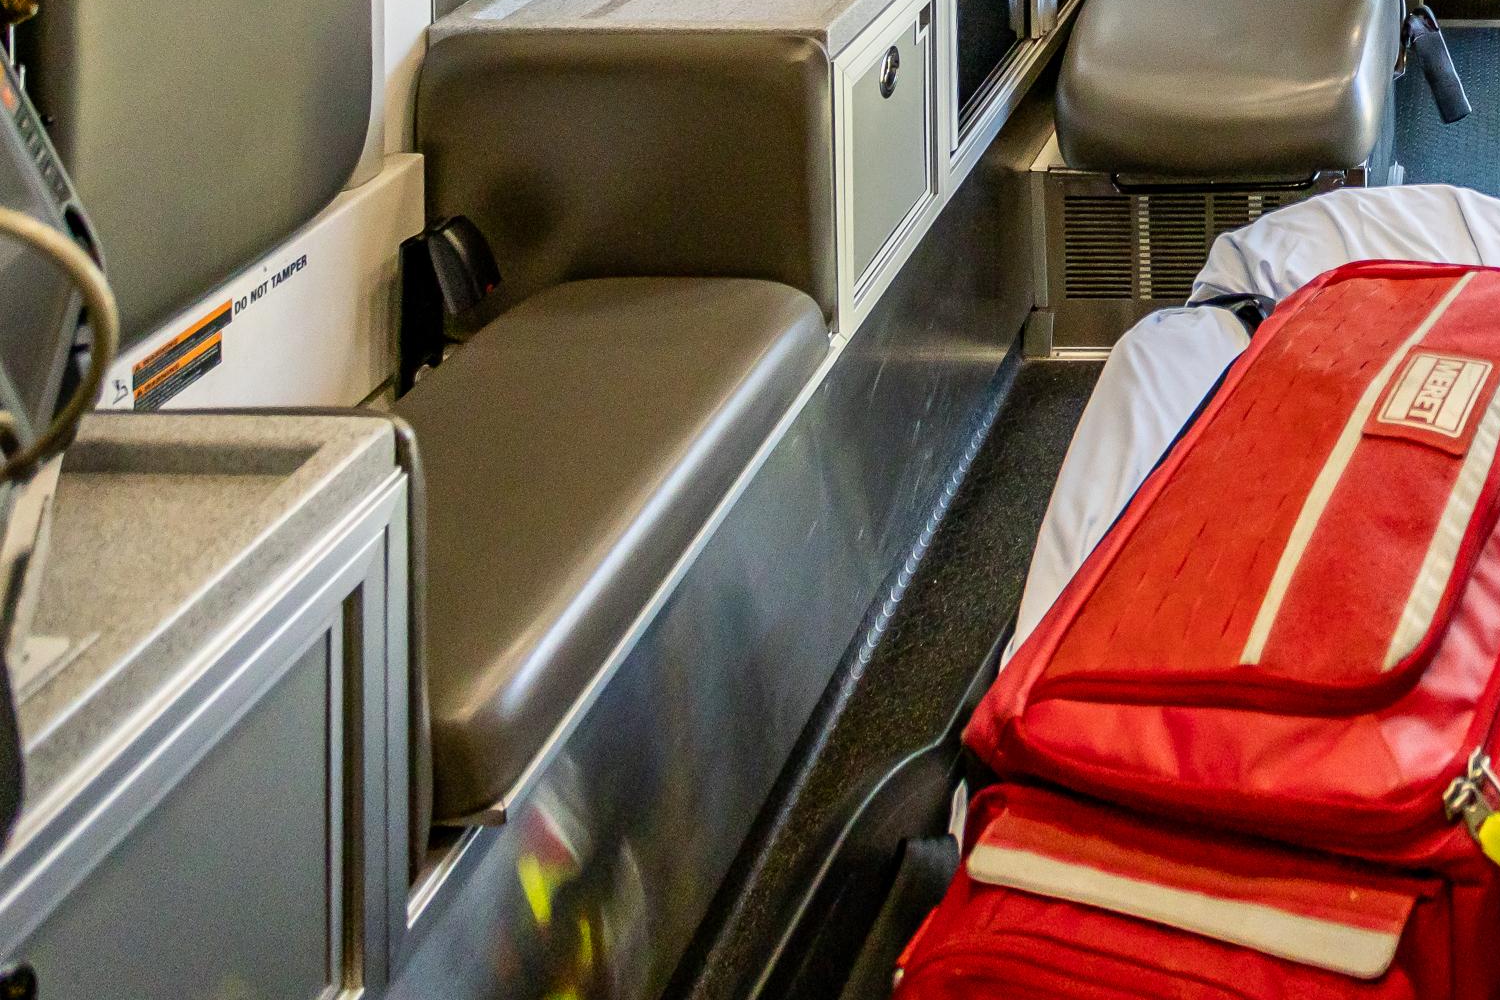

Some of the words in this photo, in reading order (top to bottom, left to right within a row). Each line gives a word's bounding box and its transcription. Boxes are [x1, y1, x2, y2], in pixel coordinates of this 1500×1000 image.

[234, 296, 248, 315] DO
[250, 282, 268, 303] NOT
[271, 254, 307, 288] TAMPER
[1405, 358, 1465, 425] MERET
